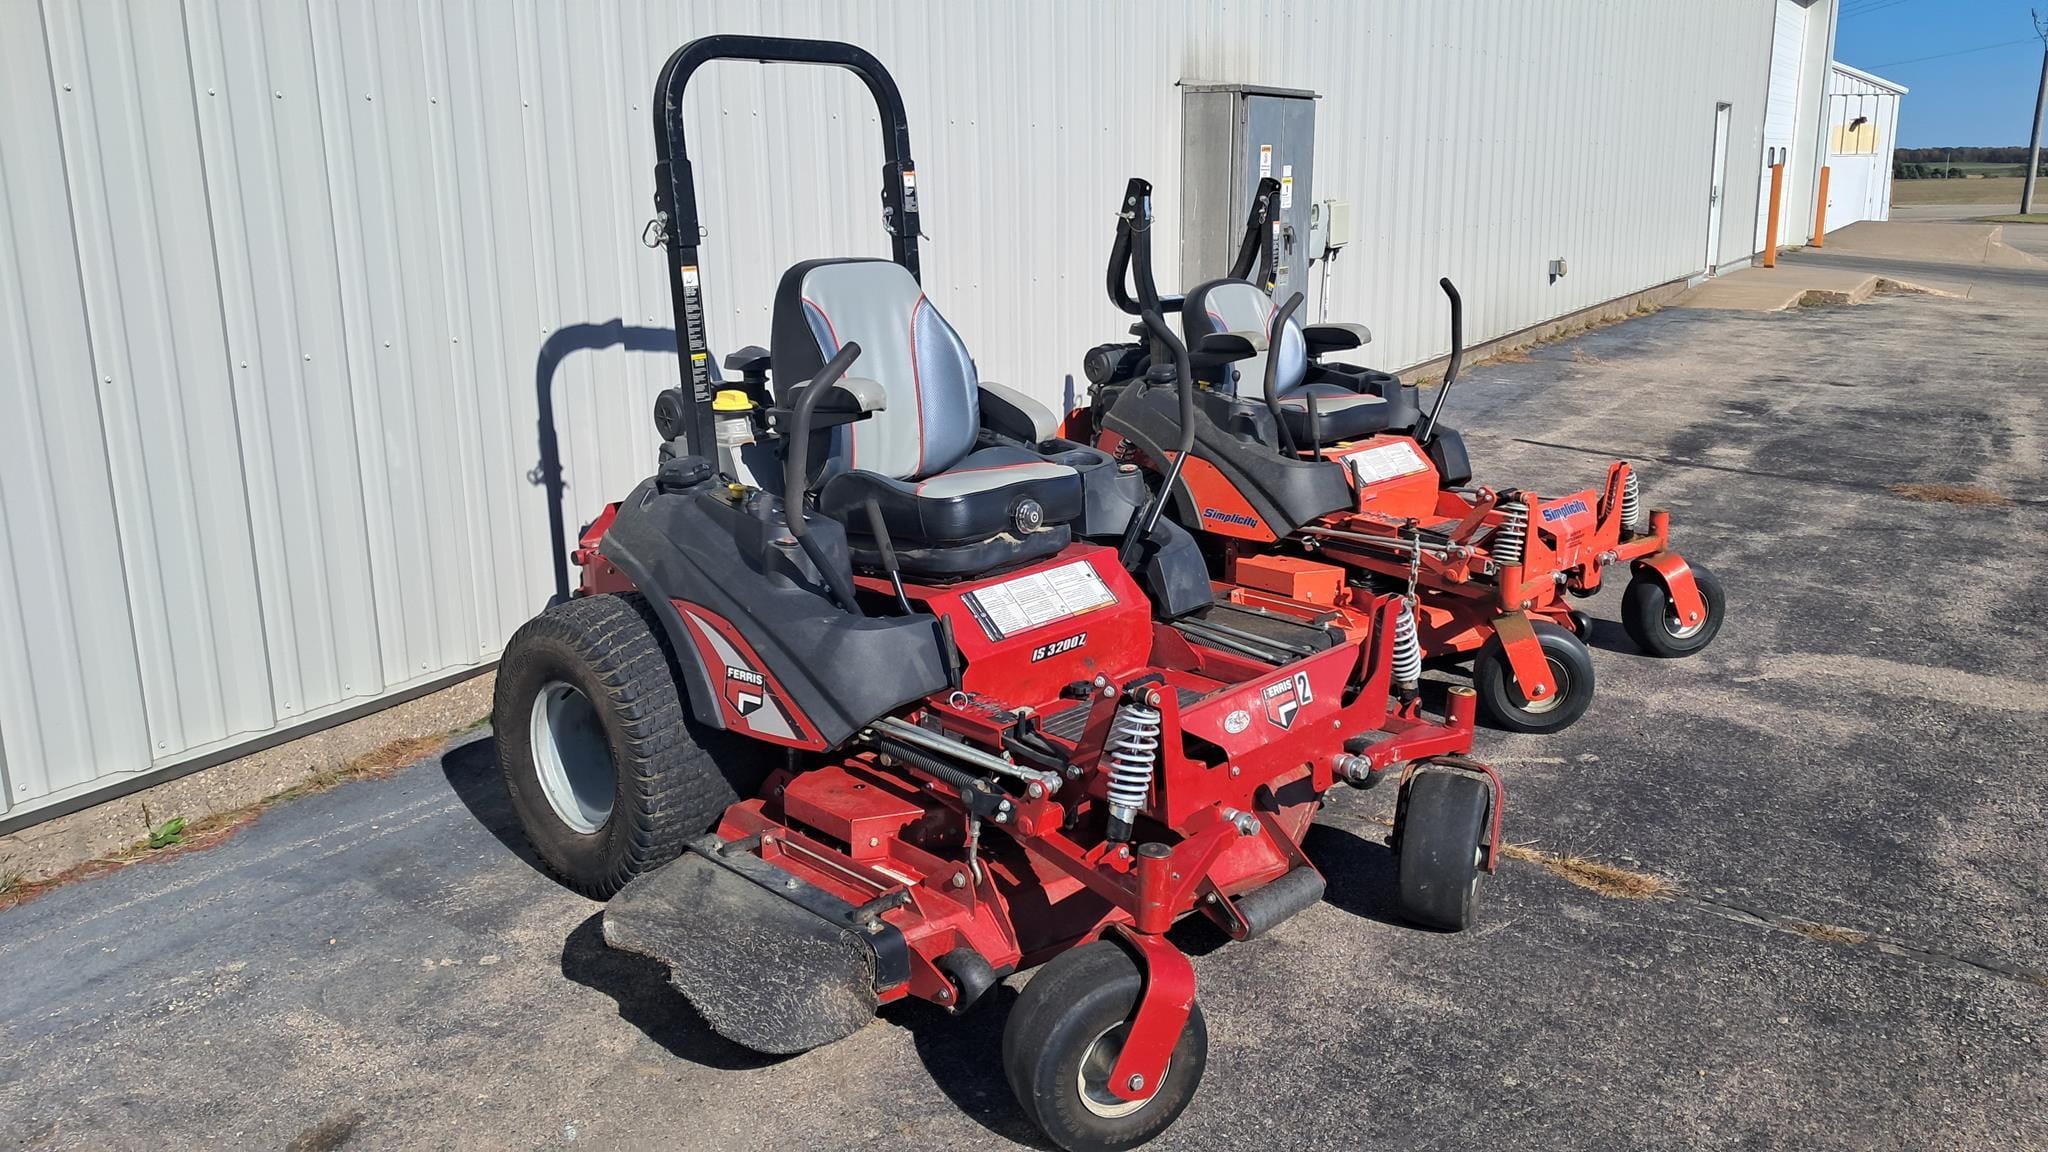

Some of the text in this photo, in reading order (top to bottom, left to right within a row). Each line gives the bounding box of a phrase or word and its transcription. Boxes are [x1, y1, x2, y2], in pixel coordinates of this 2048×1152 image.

[1203, 508, 1258, 528] Simplicity
[1542, 500, 1588, 521] Simplicity
[1032, 633, 1087, 662] IS 3200Z
[727, 667, 763, 685] FERRIS
[1297, 675, 1311, 703] 2
